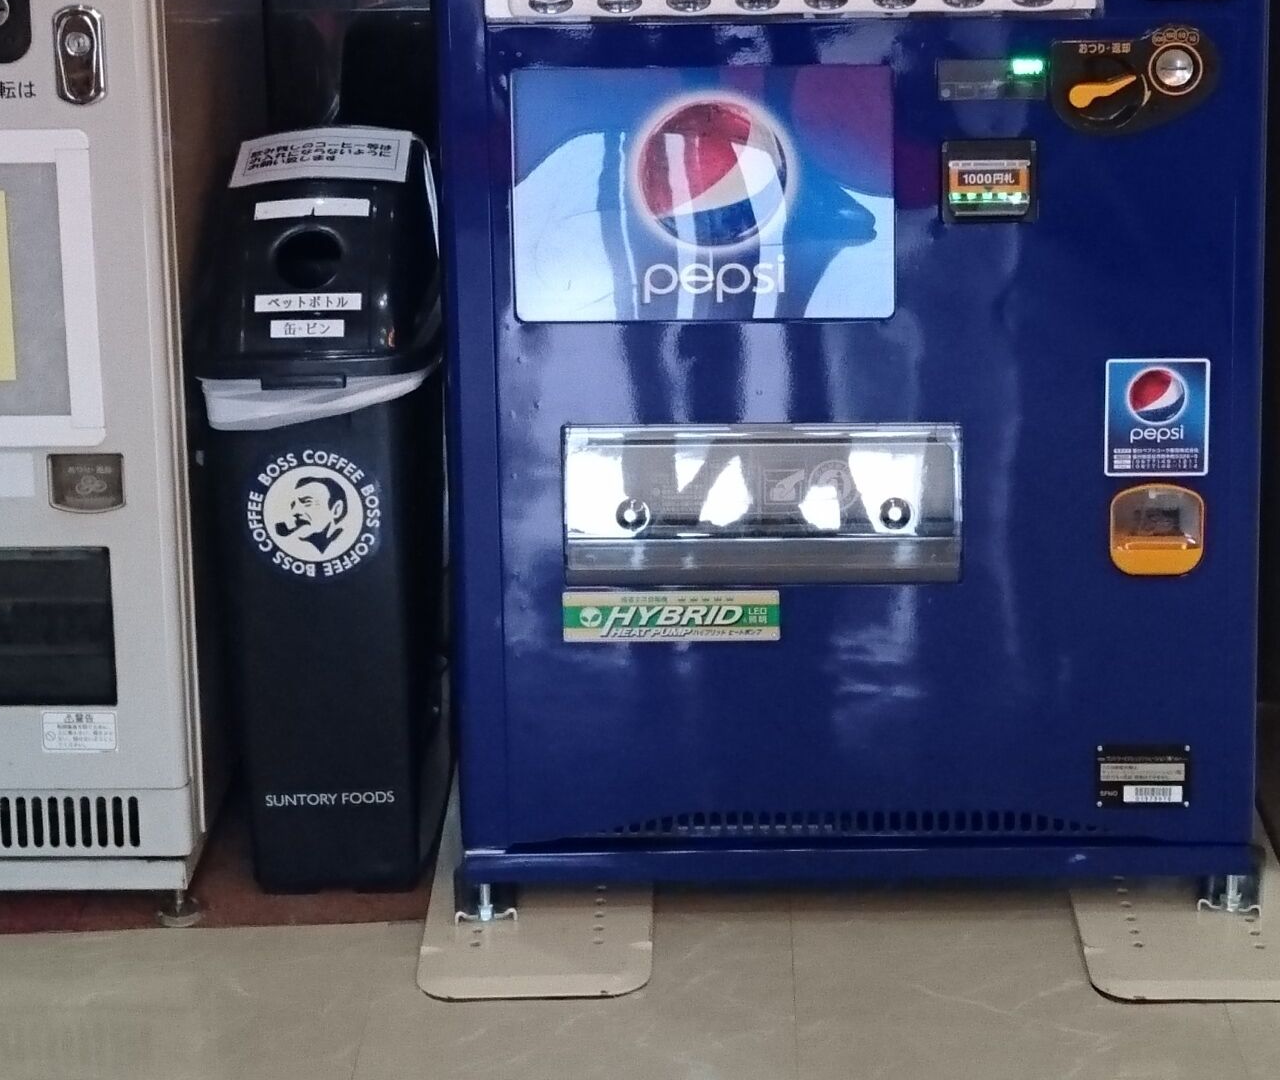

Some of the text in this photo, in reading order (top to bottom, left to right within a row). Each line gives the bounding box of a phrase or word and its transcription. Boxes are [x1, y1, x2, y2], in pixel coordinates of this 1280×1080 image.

[1079, 42, 1132, 54] おつり・返却
[963, 173, 1015, 185] 1000円札
[644, 254, 786, 304] pepsi
[268, 296, 349, 309] ペットボトル
[283, 322, 331, 335] 缶・ビン
[1130, 424, 1184, 443] pepsi
[257, 453, 298, 486] BOSS
[303, 450, 365, 483] COFFEE
[361, 484, 381, 528] BOSS
[247, 491, 273, 552] COFFEE
[272, 552, 316, 577] BOSS
[322, 533, 375, 576] COFFEE
[601, 605, 744, 633] HYBRID
[610, 628, 650, 637] HEAT
[653, 628, 692, 637] PUMP
[265, 790, 395, 807] SUNTORY FOODS
